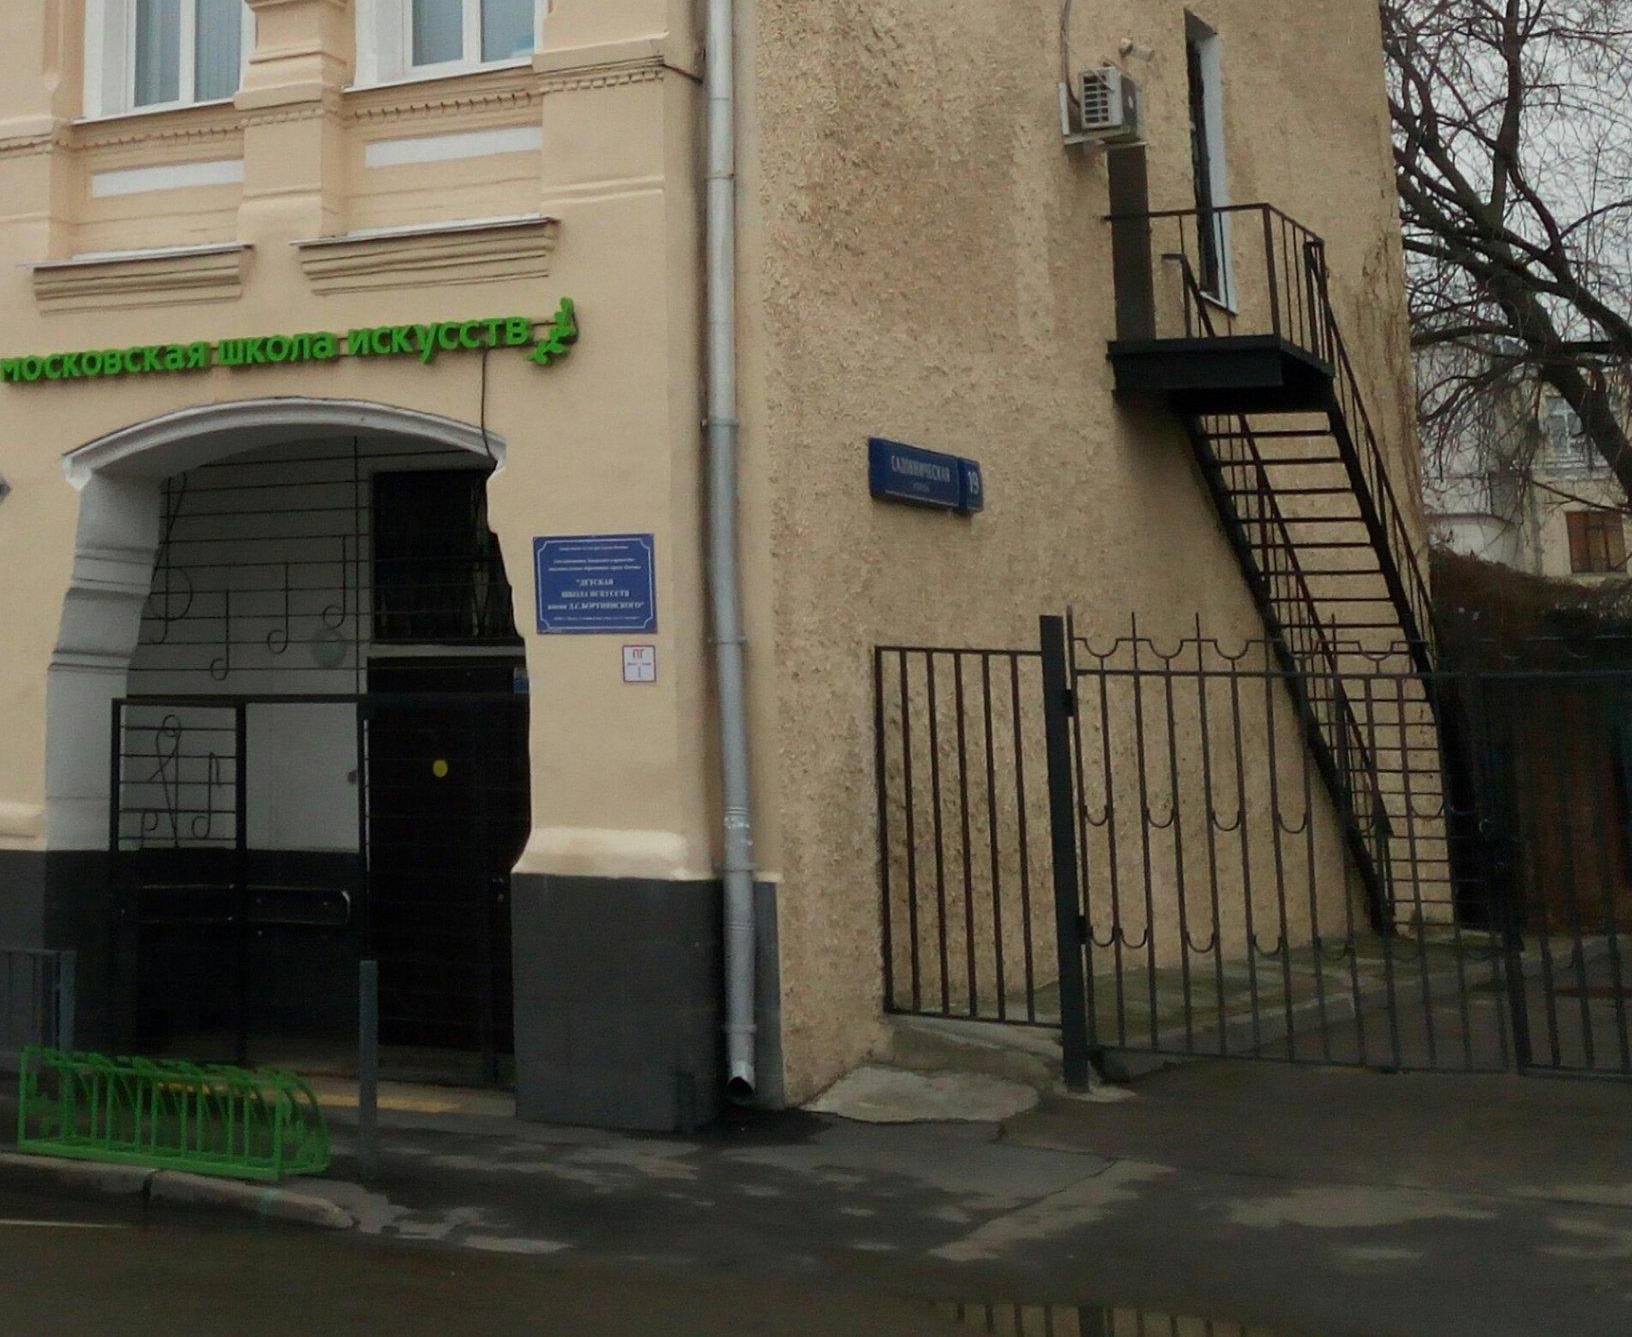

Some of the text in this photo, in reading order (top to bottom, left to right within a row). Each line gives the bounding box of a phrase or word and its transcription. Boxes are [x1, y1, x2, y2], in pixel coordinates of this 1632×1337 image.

[0, 316, 534, 383] московская школа искусств
